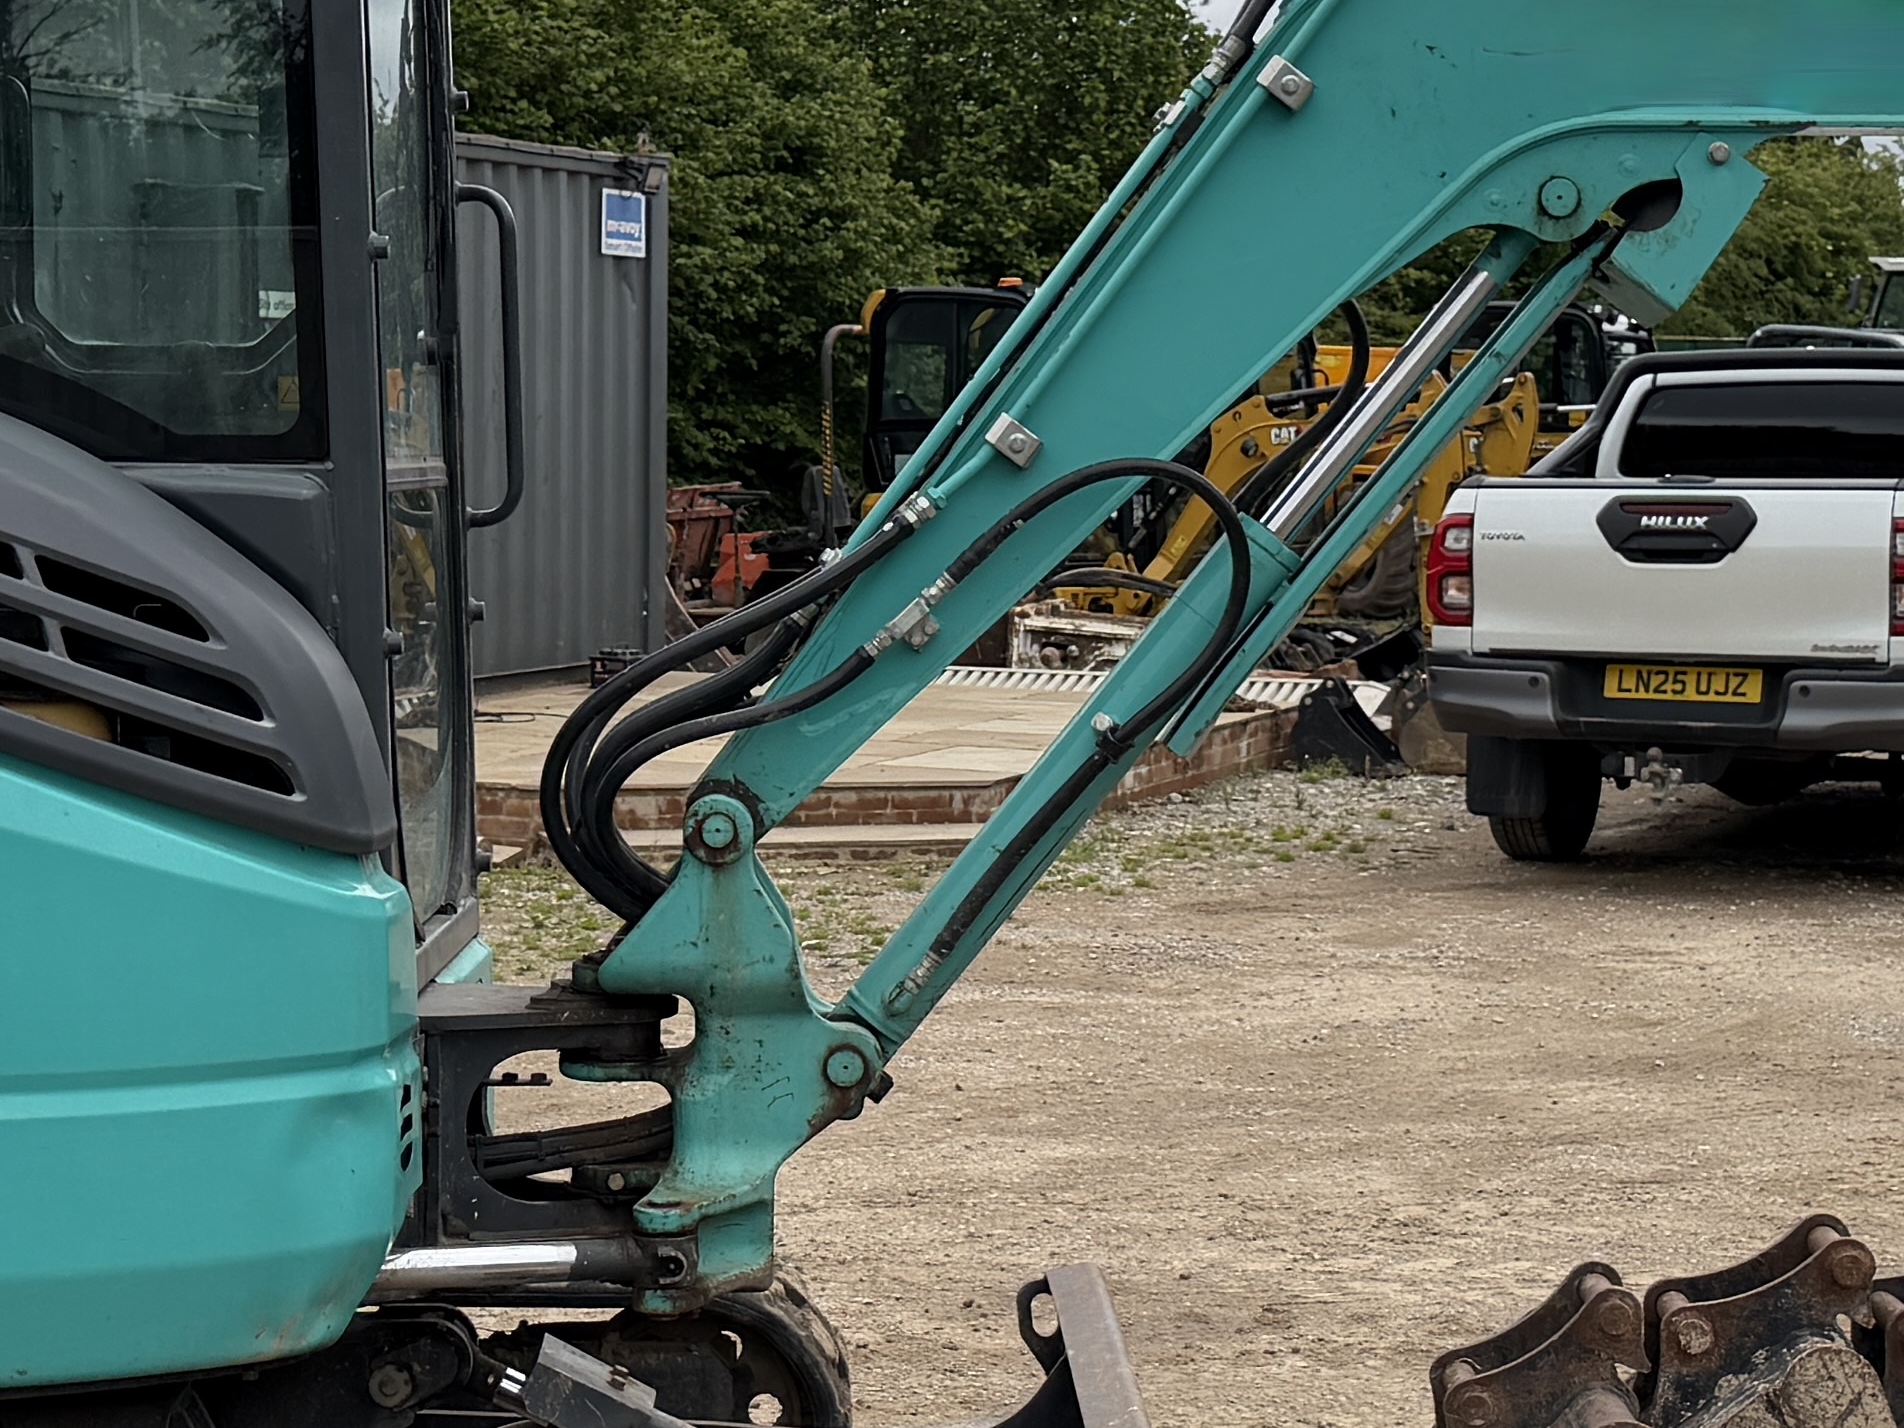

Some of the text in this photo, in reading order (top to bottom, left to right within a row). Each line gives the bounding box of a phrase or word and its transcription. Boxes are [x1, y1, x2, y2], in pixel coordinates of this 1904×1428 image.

[1271, 426, 1297, 444] CAT
[1640, 515, 1709, 529] HILUX
[1479, 532, 1526, 541] TOYOTA
[1616, 668, 1749, 697] LN25 UJZ
